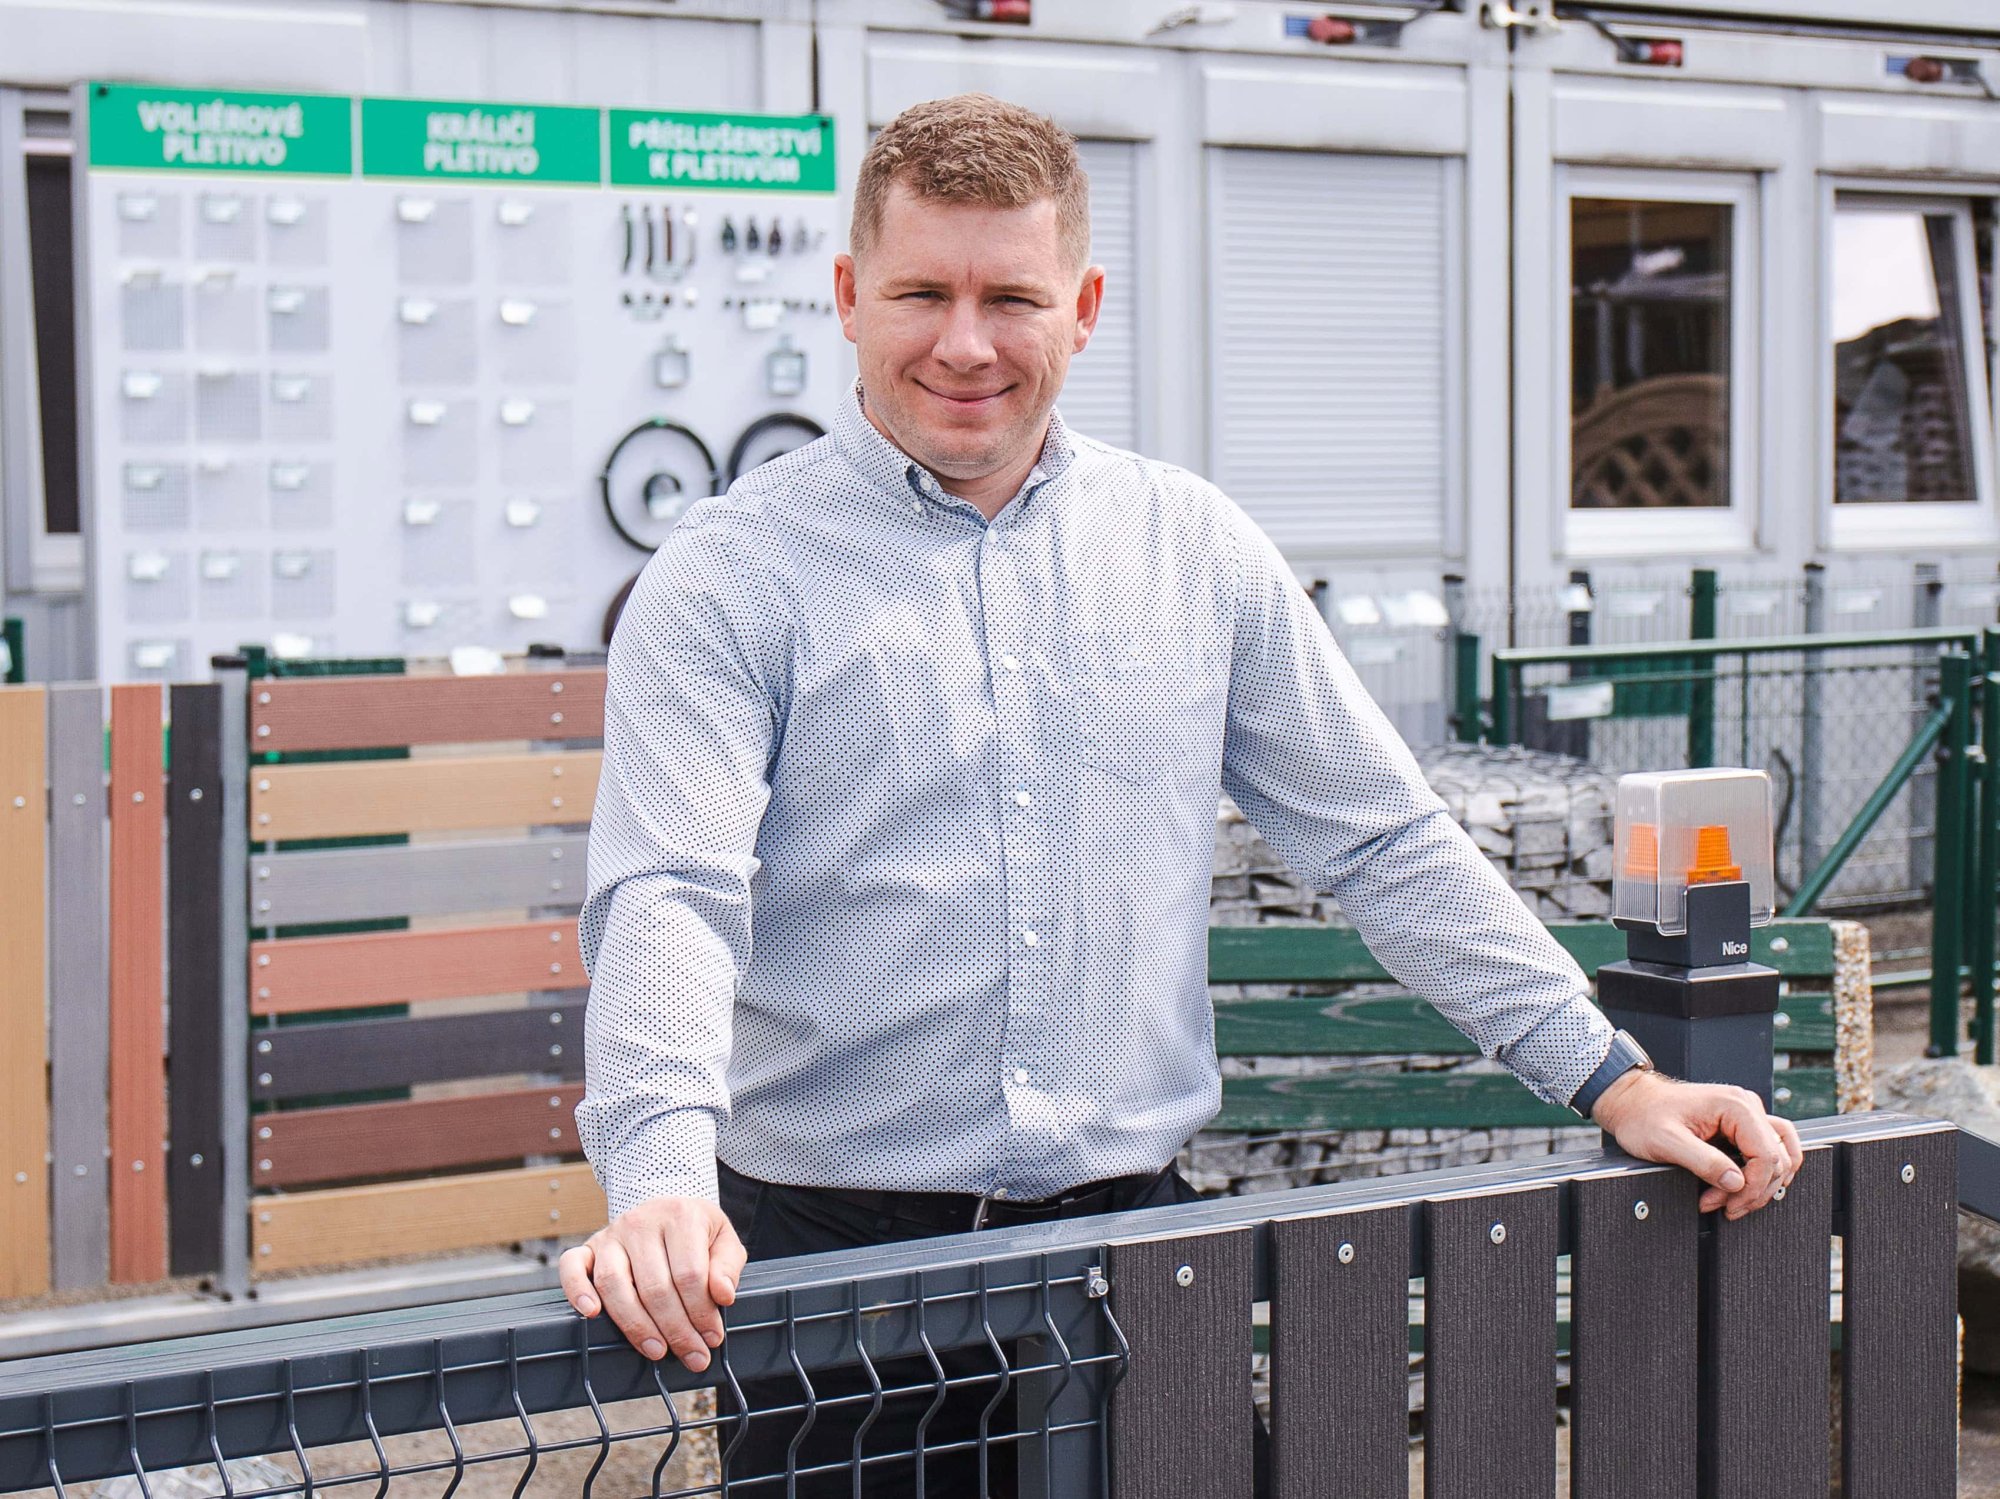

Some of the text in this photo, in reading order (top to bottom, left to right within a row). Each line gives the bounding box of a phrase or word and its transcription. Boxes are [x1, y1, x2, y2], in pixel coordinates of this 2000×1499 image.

[163, 134, 286, 166] PLETIVO
[424, 143, 538, 174] PLETIVO
[650, 153, 669, 178] K
[1722, 941, 1748, 956] Nice
